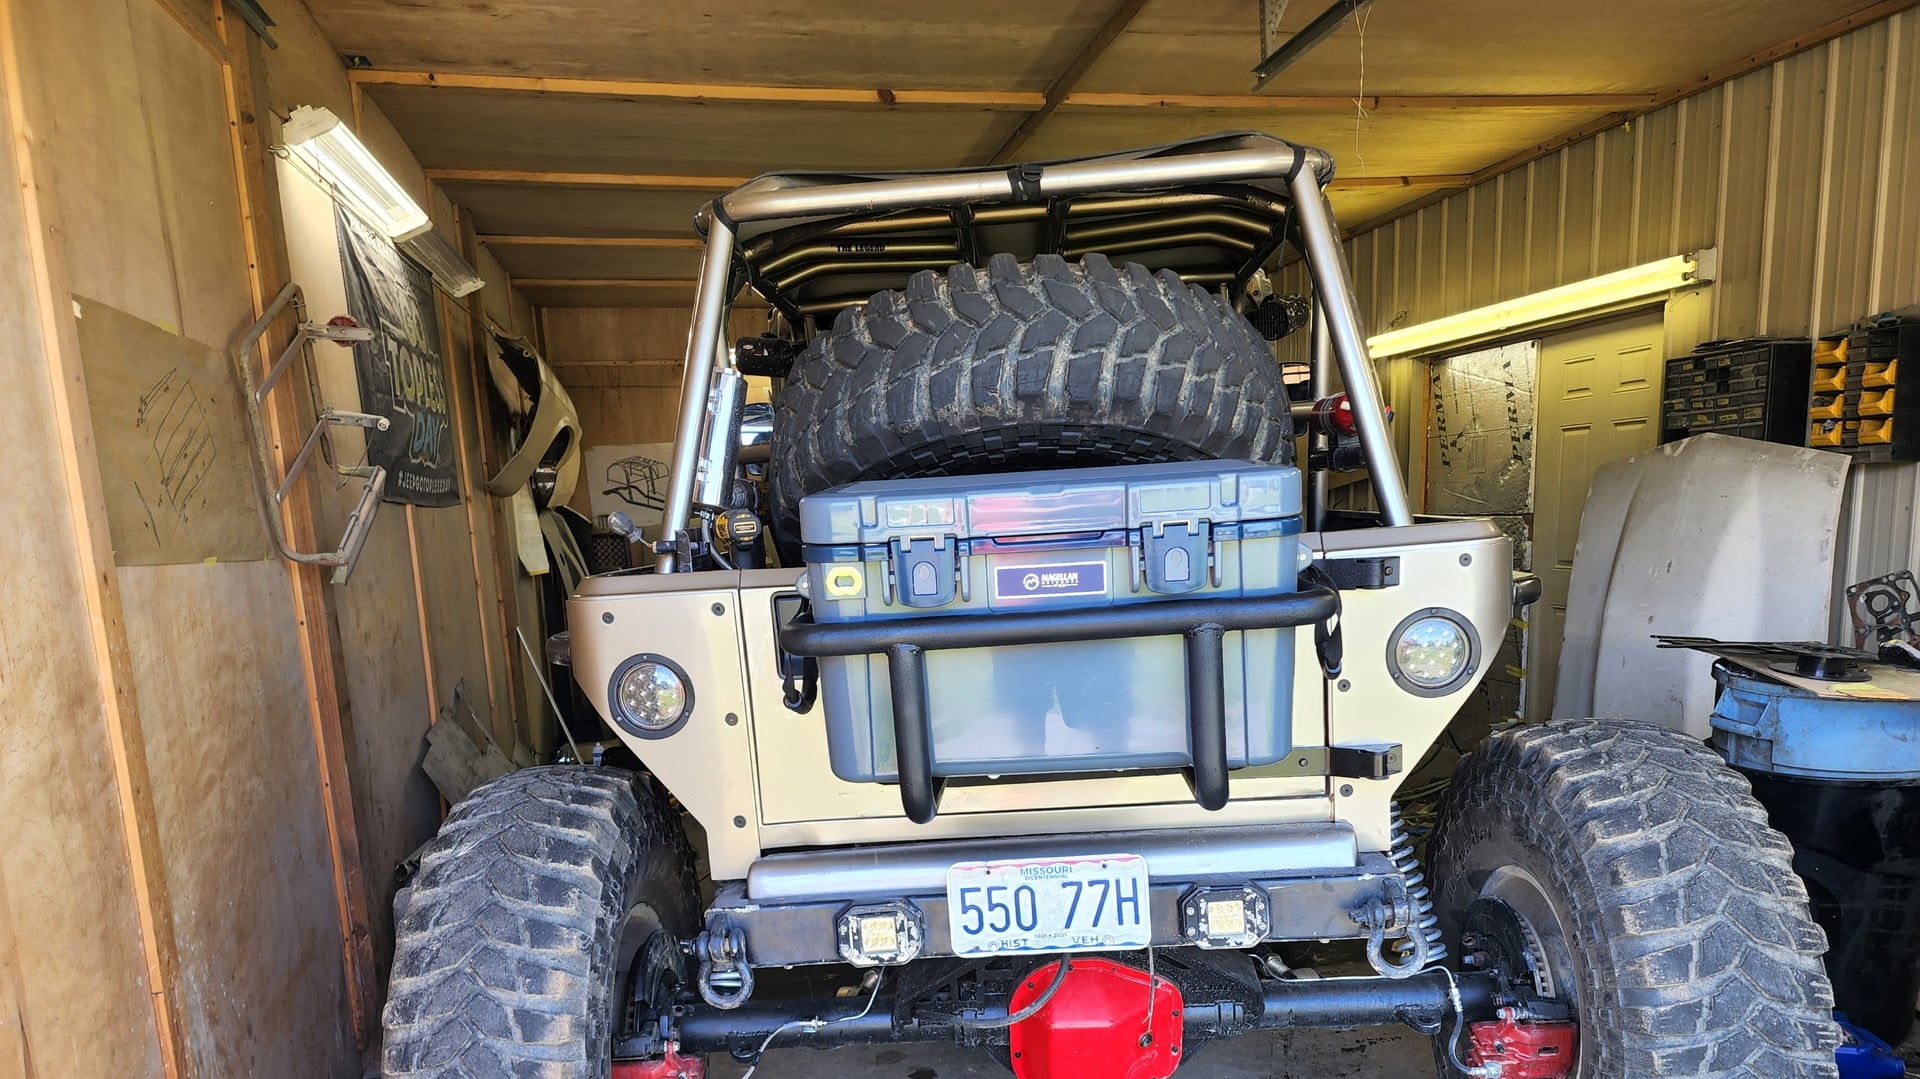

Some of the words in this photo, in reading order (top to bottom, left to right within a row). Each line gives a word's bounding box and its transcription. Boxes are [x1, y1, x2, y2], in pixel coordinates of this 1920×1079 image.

[387, 335, 447, 415] TOPLESS
[1431, 374, 1451, 468] PERMA
[1503, 360, 1524, 464] PERMA
[413, 411, 440, 457] DAY
[1042, 572, 1078, 581] MAGELLAN
[1020, 866, 1073, 876] MISSOURI
[1024, 873, 1068, 881] BICENTENNIAL
[960, 885, 1037, 934] 550
[1061, 878, 1140, 930] 77H
[1001, 938, 1029, 948] HIST
[1072, 935, 1099, 945] VEH
